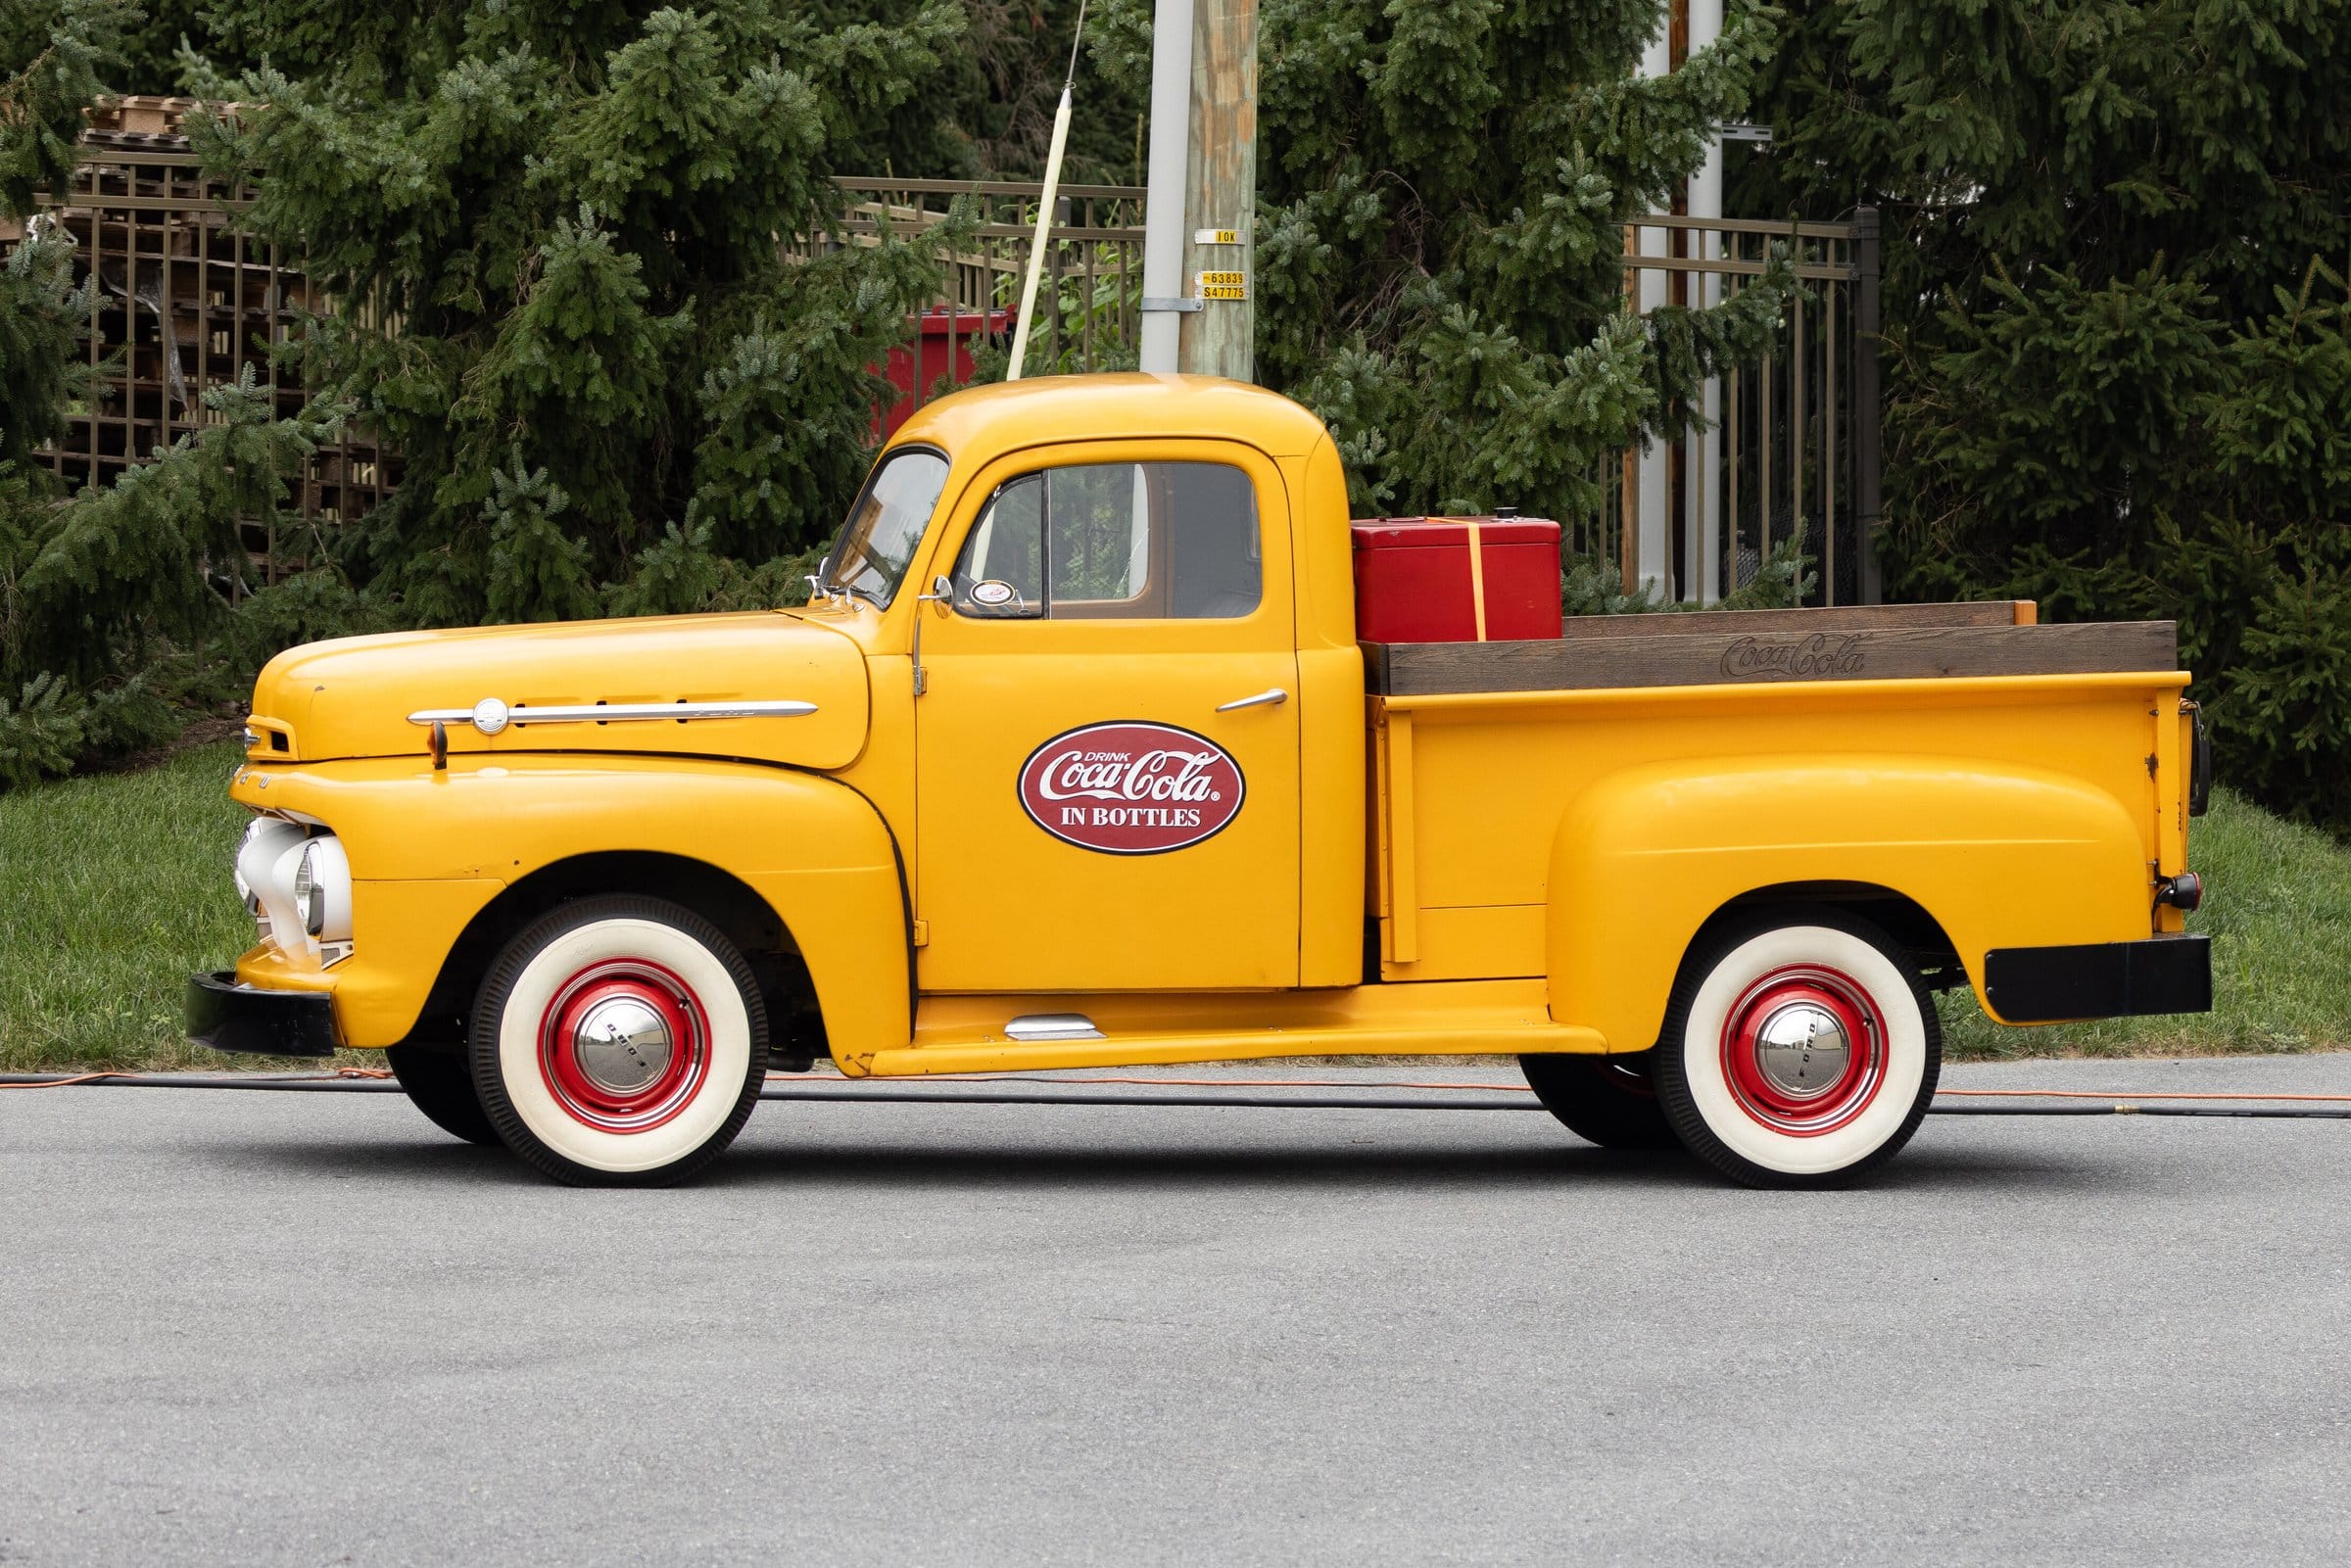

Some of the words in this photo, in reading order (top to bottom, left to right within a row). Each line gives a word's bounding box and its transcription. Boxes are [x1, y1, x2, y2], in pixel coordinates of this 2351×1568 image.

[1204, 287, 1244, 298] S47775
[1084, 752, 1131, 762] DRINK
[1061, 808, 1086, 826] IN
[1092, 808, 1202, 828] BOTTLES
[1799, 1023, 1816, 1077] FORD
